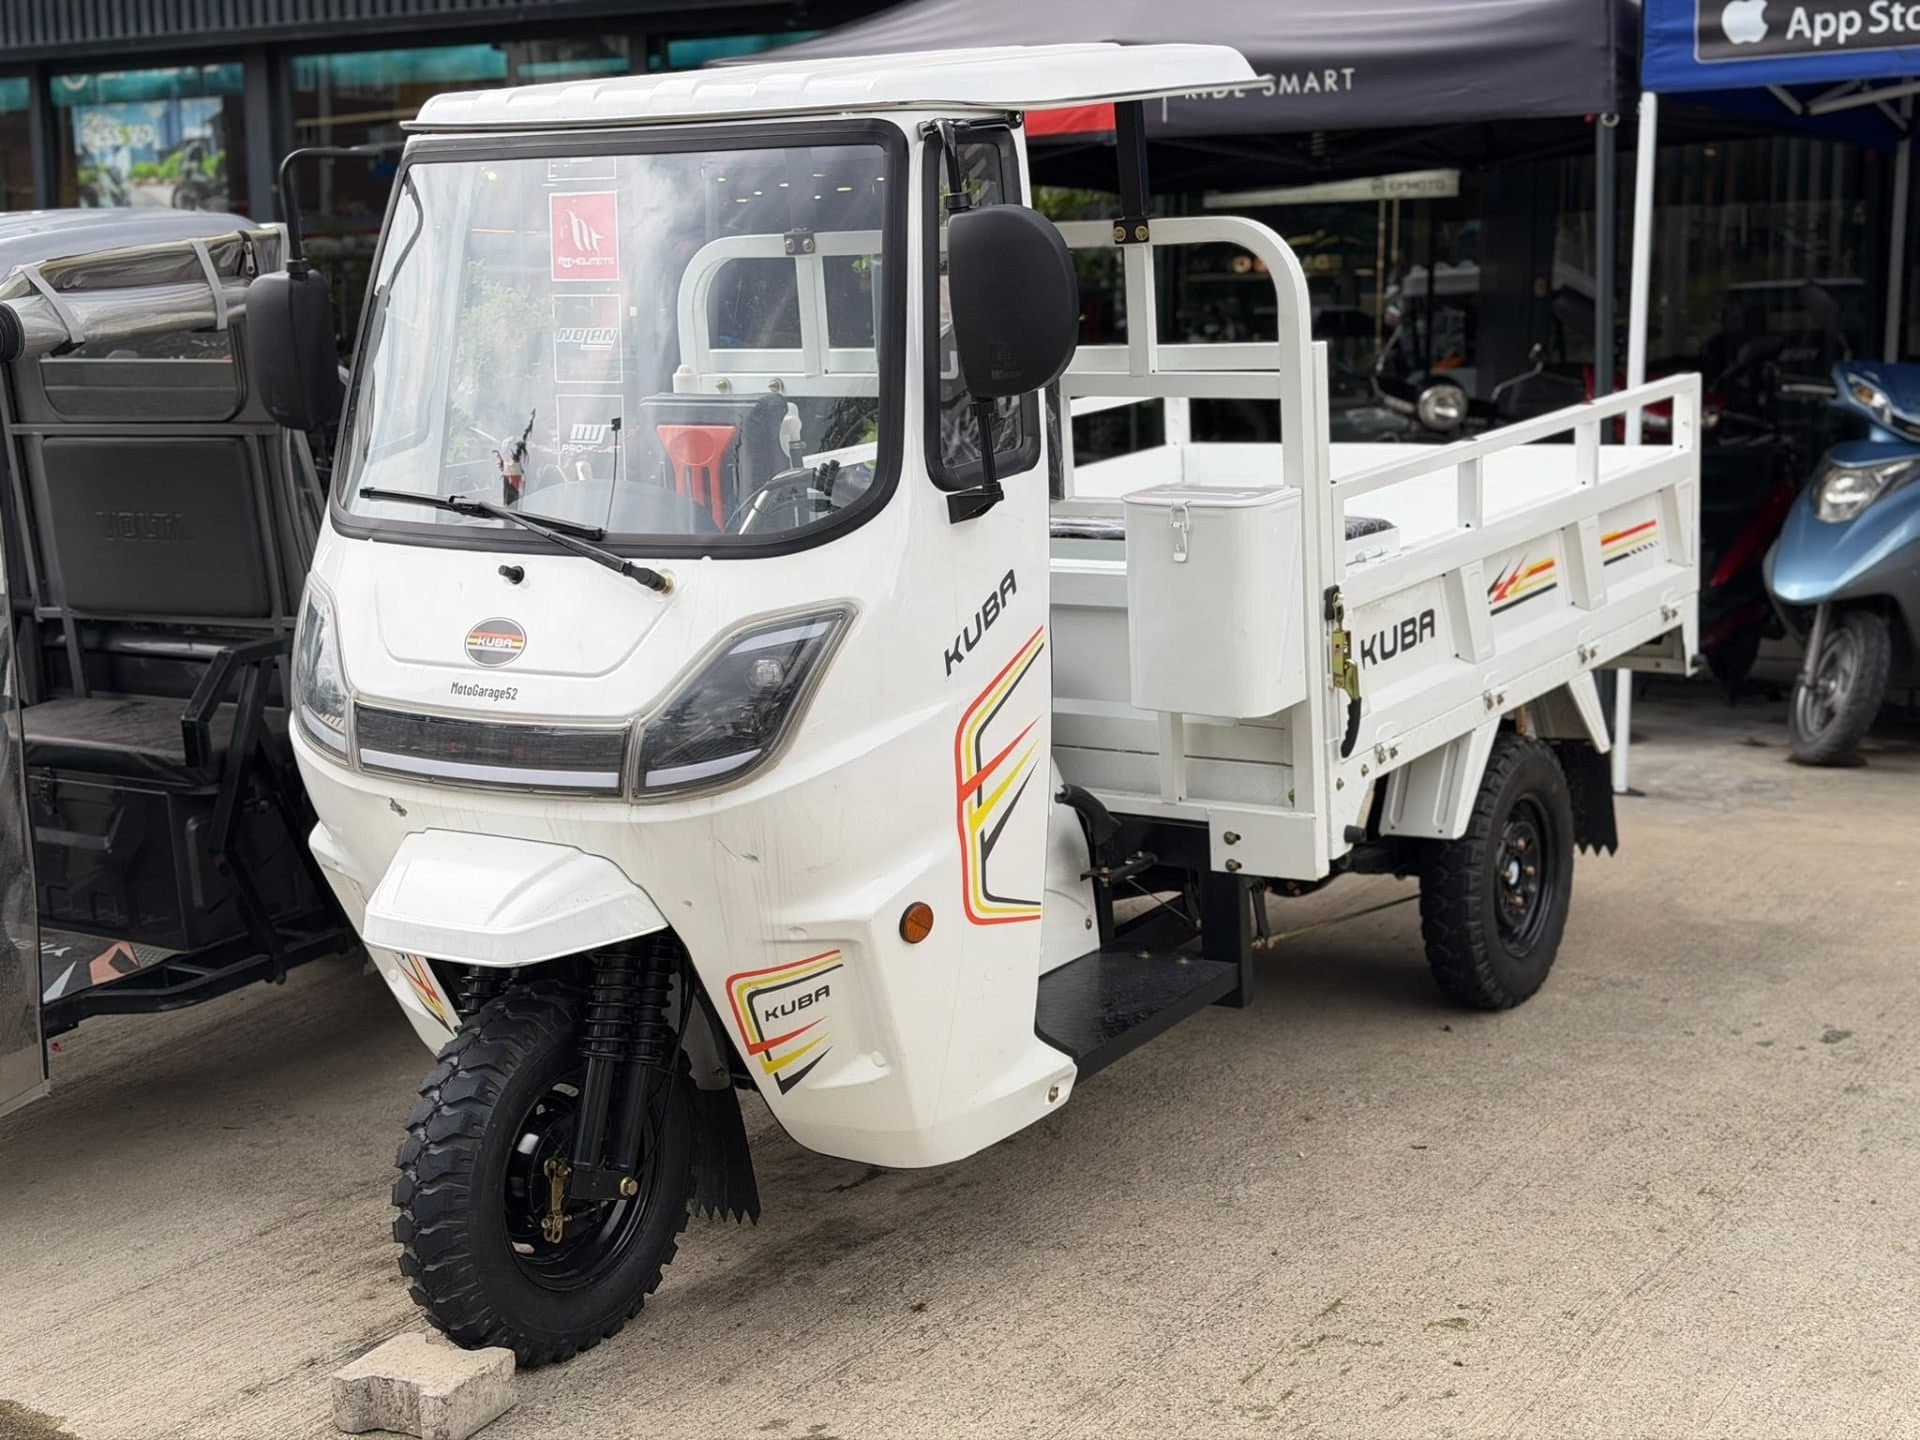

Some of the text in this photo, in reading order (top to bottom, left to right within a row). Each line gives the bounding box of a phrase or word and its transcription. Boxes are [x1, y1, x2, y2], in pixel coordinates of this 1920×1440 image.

[1785, 6, 1862, 46] App
[1262, 68, 1355, 97] SMART
[558, 328, 617, 349] NOLAN
[944, 569, 1017, 677] KUBA
[1361, 608, 1435, 670] KUBA
[476, 635, 514, 648] KUBA
[450, 681, 519, 701] MotoGarage52
[764, 984, 831, 1022] KUBA
